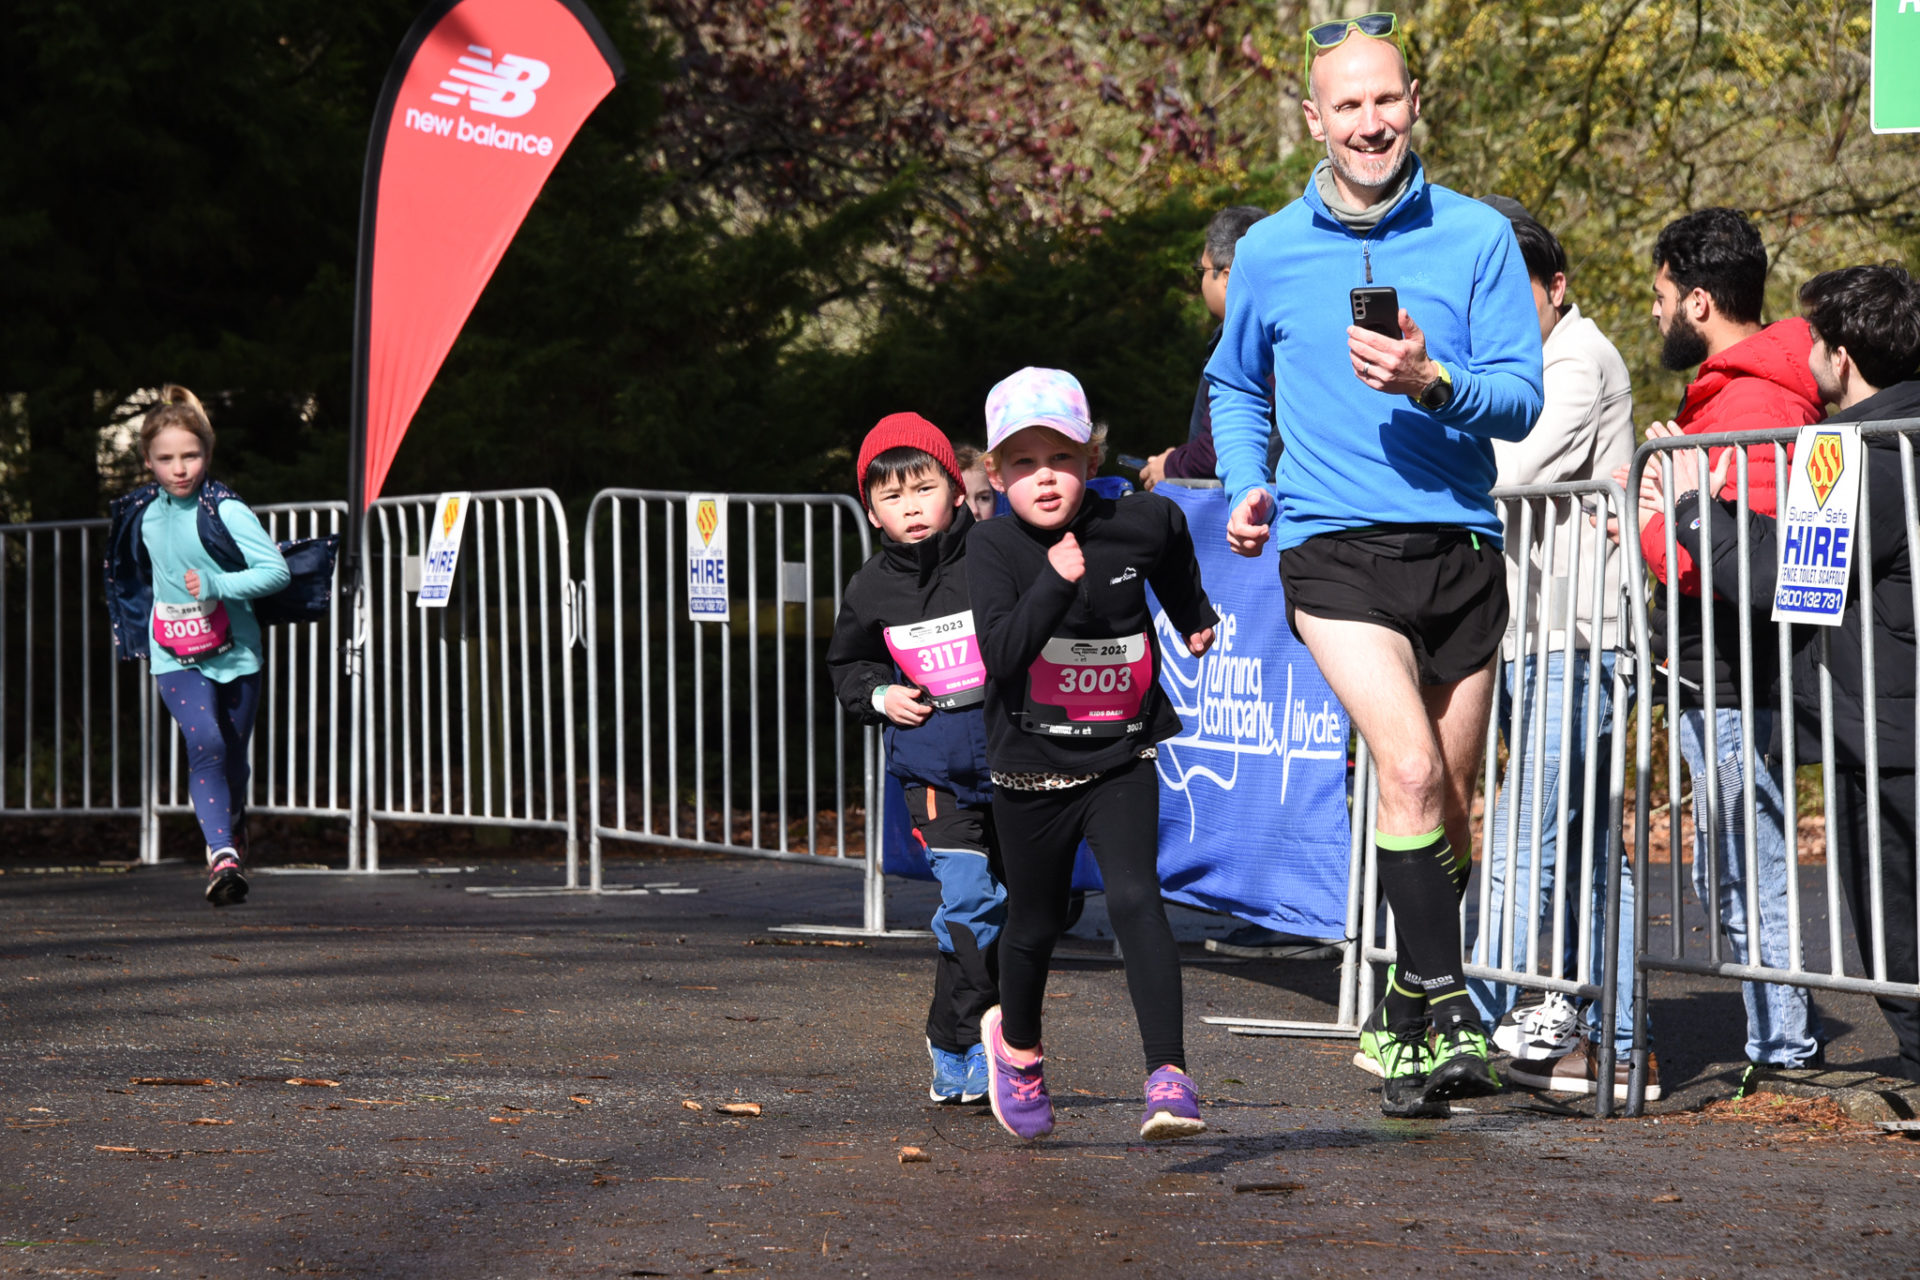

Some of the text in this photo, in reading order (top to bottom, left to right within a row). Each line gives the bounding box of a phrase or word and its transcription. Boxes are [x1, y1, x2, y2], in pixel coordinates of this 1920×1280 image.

[405, 107, 554, 157] new balance
[1788, 506, 1848, 524] Super Safe
[1783, 525, 1850, 569] HIRE
[427, 550, 455, 573] HIRE
[690, 559, 725, 584] HIRE
[1818, 569, 1846, 586] SCAFFOLD
[163, 617, 212, 639] 3005
[935, 620, 964, 634] 2023
[1212, 603, 1237, 652] the
[917, 640, 969, 673] 3117
[1100, 644, 1128, 656] 2023
[1058, 666, 1132, 694] 3003
[1105, 709, 1124, 717] DASH
[1126, 721, 1143, 733] 3003
